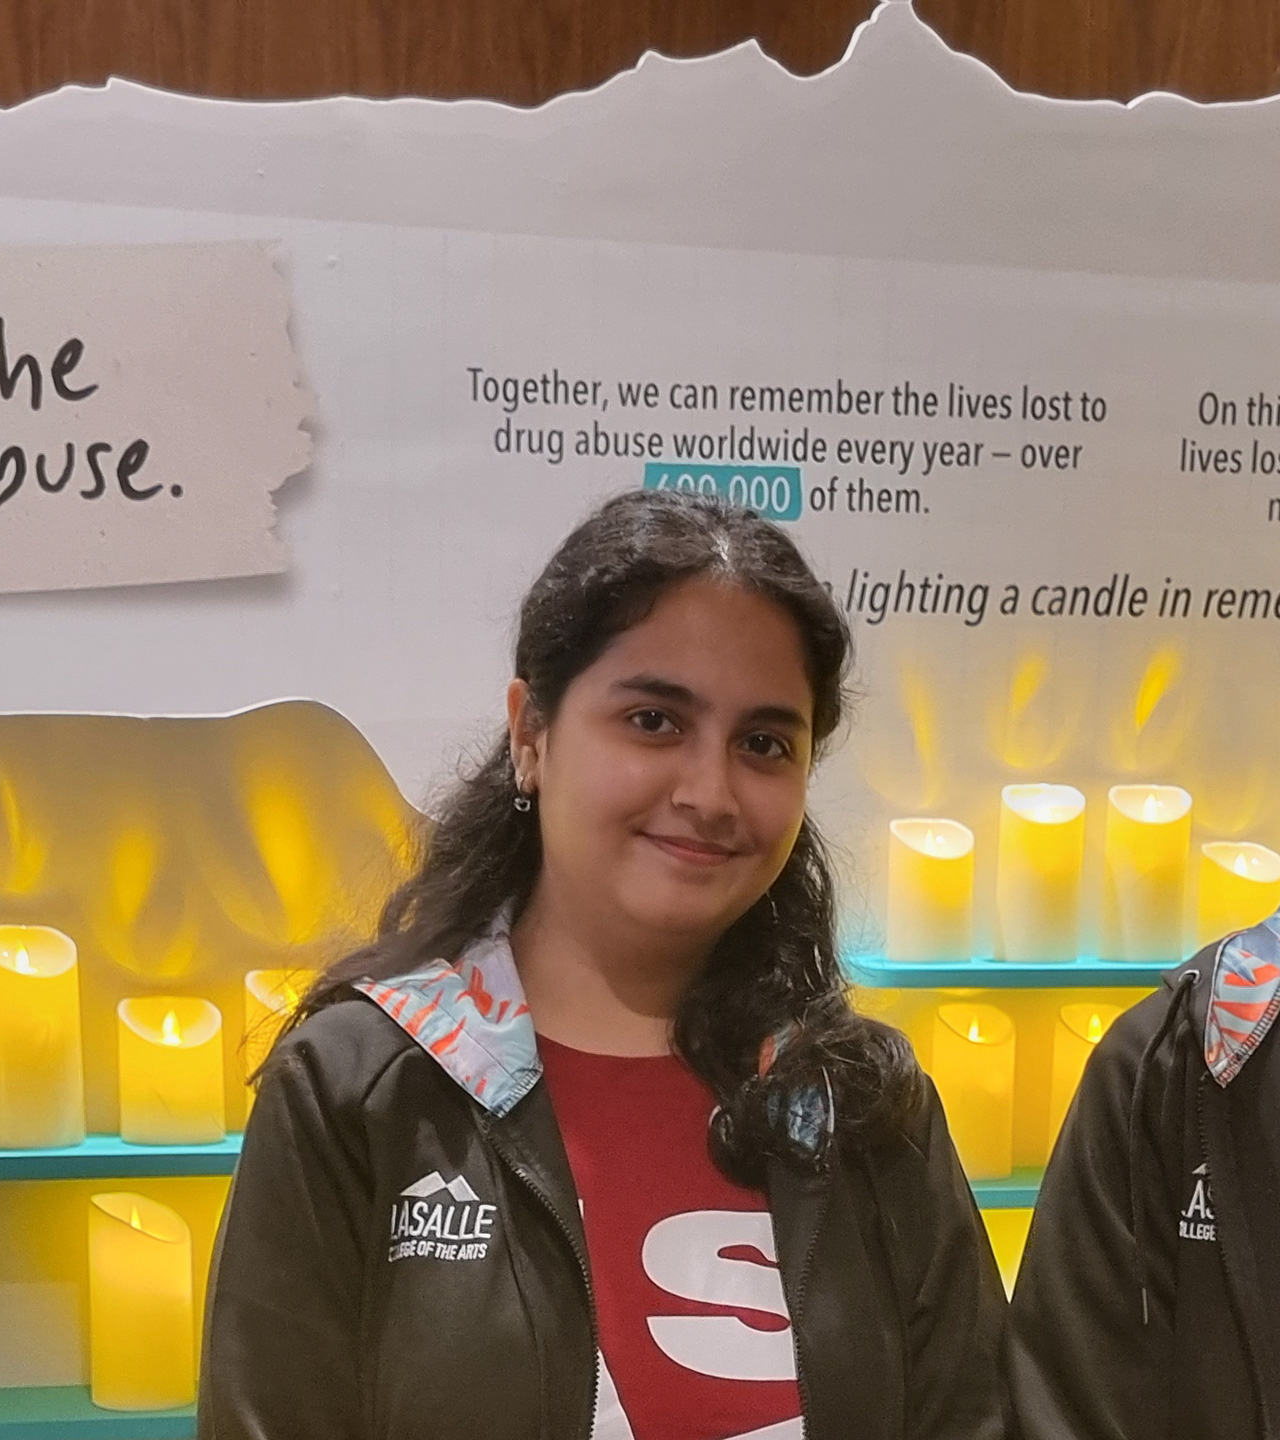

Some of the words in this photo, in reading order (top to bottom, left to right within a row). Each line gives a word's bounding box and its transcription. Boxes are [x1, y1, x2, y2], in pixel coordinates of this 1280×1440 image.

[467, 367, 609, 413] Together,
[618, 382, 660, 408] we
[669, 383, 718, 411] can
[729, 378, 885, 415] remember
[891, 380, 939, 418] the
[948, 382, 1012, 421] lives
[1021, 384, 1073, 422] lost
[1080, 391, 1107, 423] to
[1198, 391, 1237, 426] On
[494, 417, 564, 465] drug
[575, 420, 663, 458] abuse
[672, 424, 827, 463] worldwide
[837, 438, 915, 476] every
[921, 441, 984, 476] year
[1020, 443, 1083, 469] over
[1179, 438, 1242, 474] lives
[809, 475, 840, 512] of
[846, 477, 931, 514] them.
[845, 568, 990, 627] lighting
[999, 584, 1020, 615] a
[1031, 572, 1148, 618] candle
[1158, 577, 1192, 618] in
[390, 1200, 498, 1240] LASALLE
[416, 1240, 435, 1257] OF
[434, 1241, 459, 1261] THE
[457, 1242, 489, 1261] ARTS
